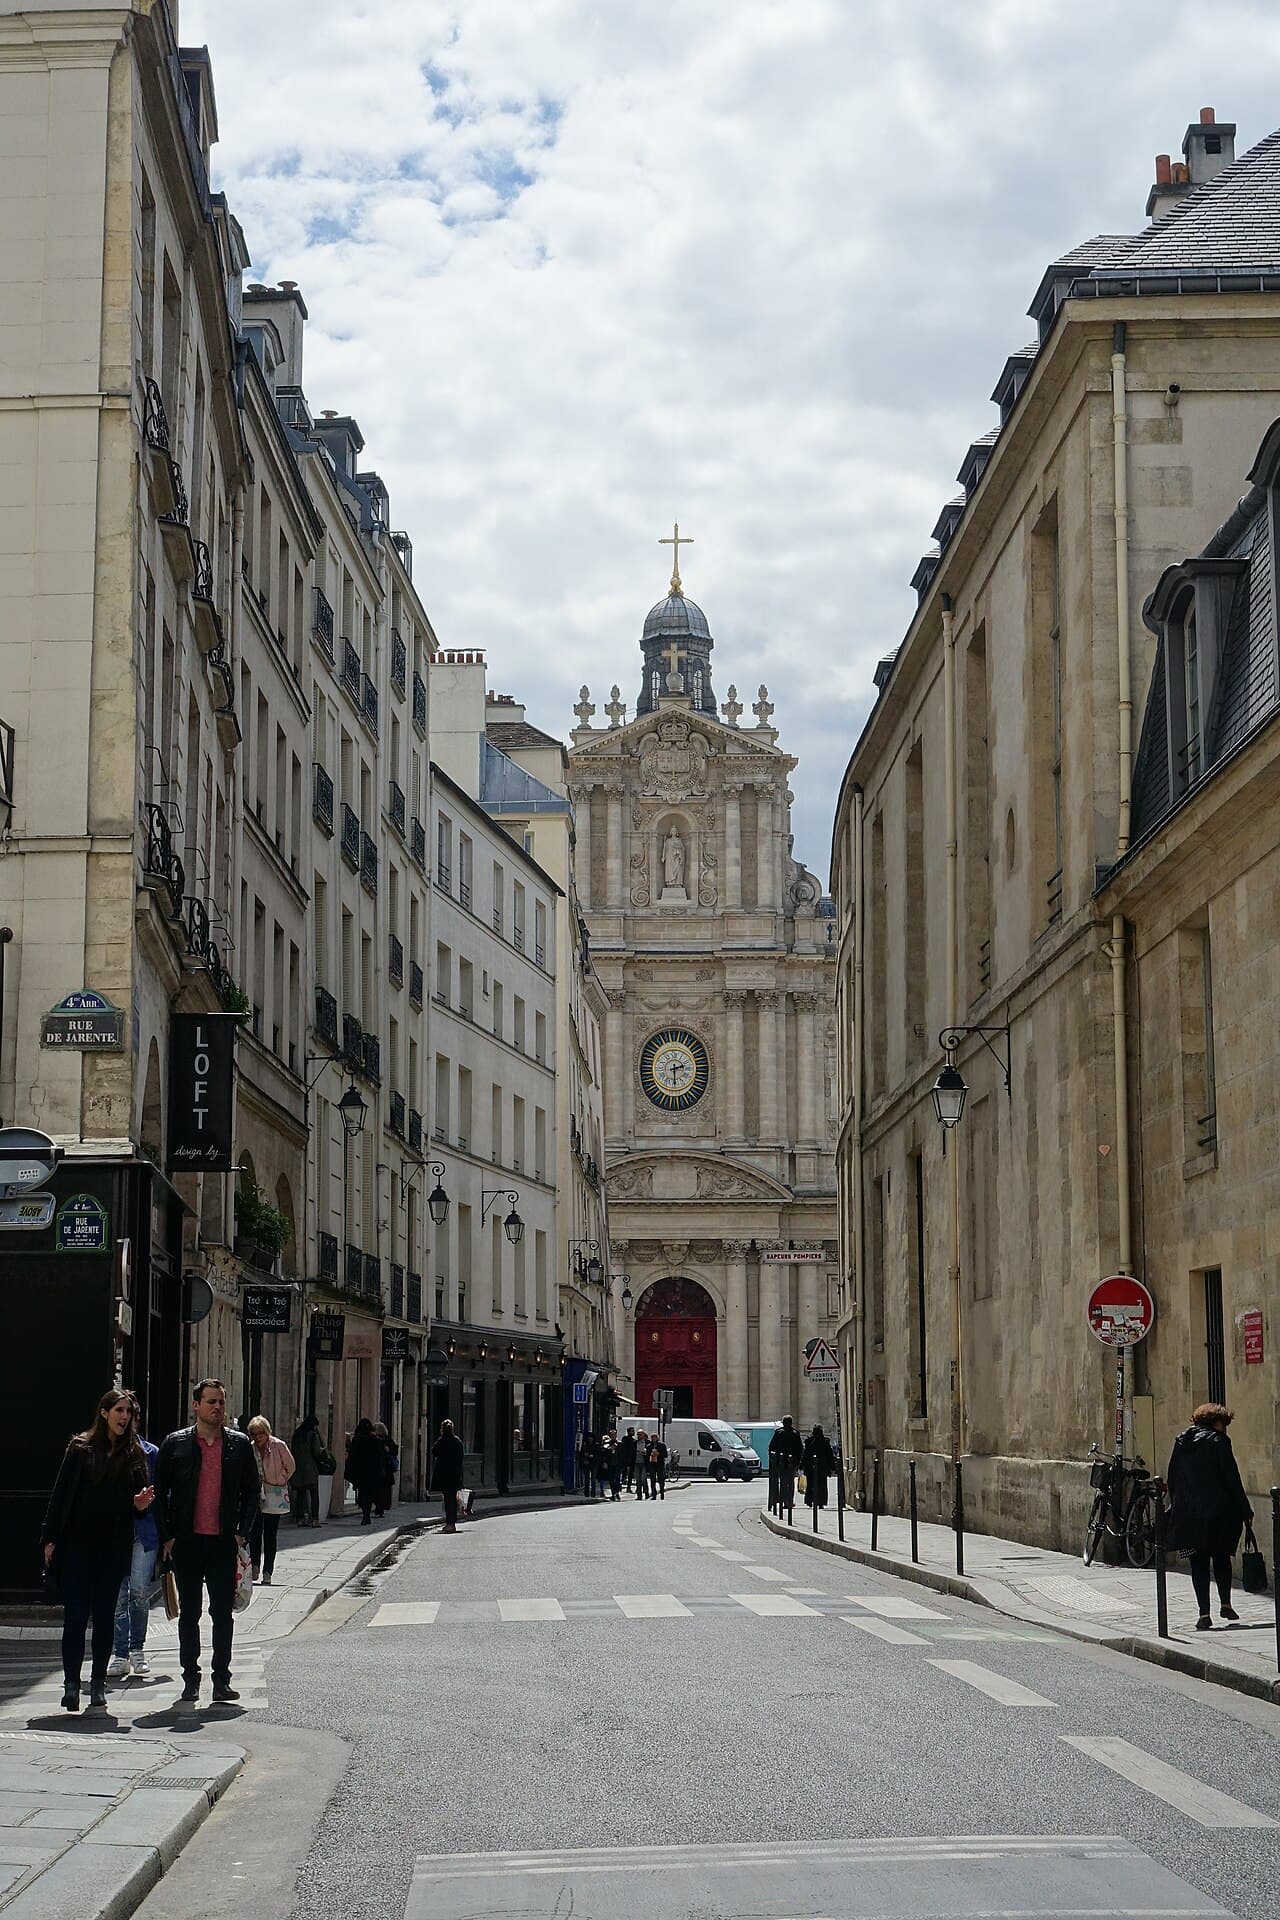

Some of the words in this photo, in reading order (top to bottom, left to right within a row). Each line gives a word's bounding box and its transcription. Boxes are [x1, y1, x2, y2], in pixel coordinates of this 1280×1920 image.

[68, 1020, 93, 1030] RUE
[46, 1033, 62, 1043] DE
[192, 1026, 210, 1130] LOFT
[174, 1144, 202, 1160] design
[205, 1144, 219, 1160] by
[75, 1217, 88, 1226] RUE
[63, 1226, 72, 1234] DE
[74, 1226, 100, 1234] JARENTE
